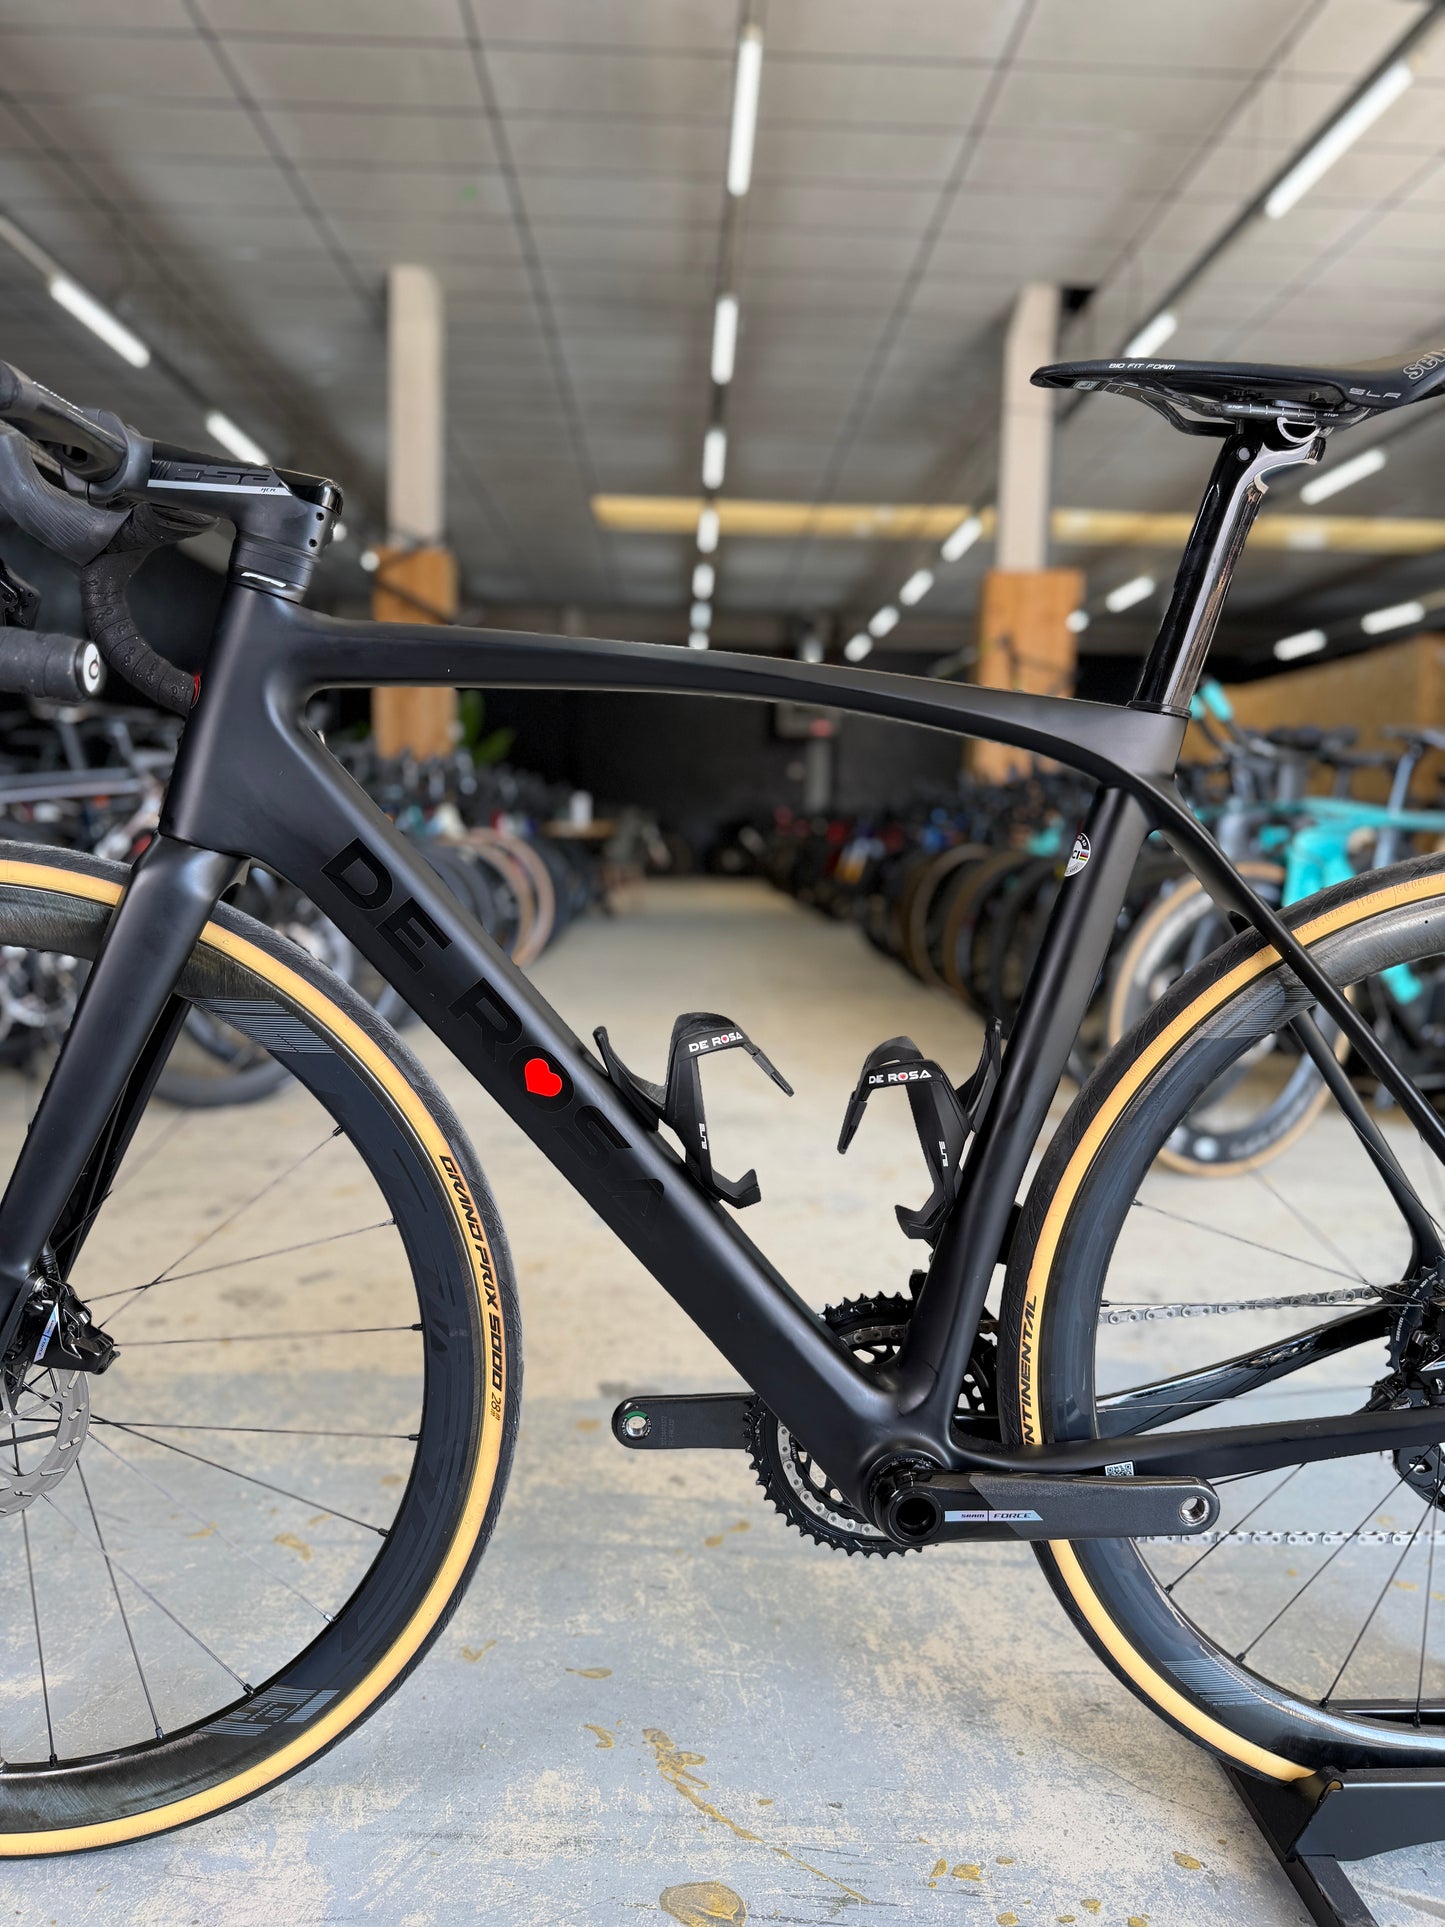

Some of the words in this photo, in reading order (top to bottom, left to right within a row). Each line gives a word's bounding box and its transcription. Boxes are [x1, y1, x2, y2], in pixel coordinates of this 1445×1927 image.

[1349, 387, 1402, 400] SLR
[320, 837, 453, 975] DE
[688, 1040, 709, 1053] DE
[712, 1031, 744, 1047] ROSA
[868, 1074, 884, 1084] DE
[888, 1069, 932, 1082] ROSA
[439, 1154, 484, 1242] GRAND
[474, 1243, 499, 1312] PRIX
[488, 1313, 503, 1392] 5000
